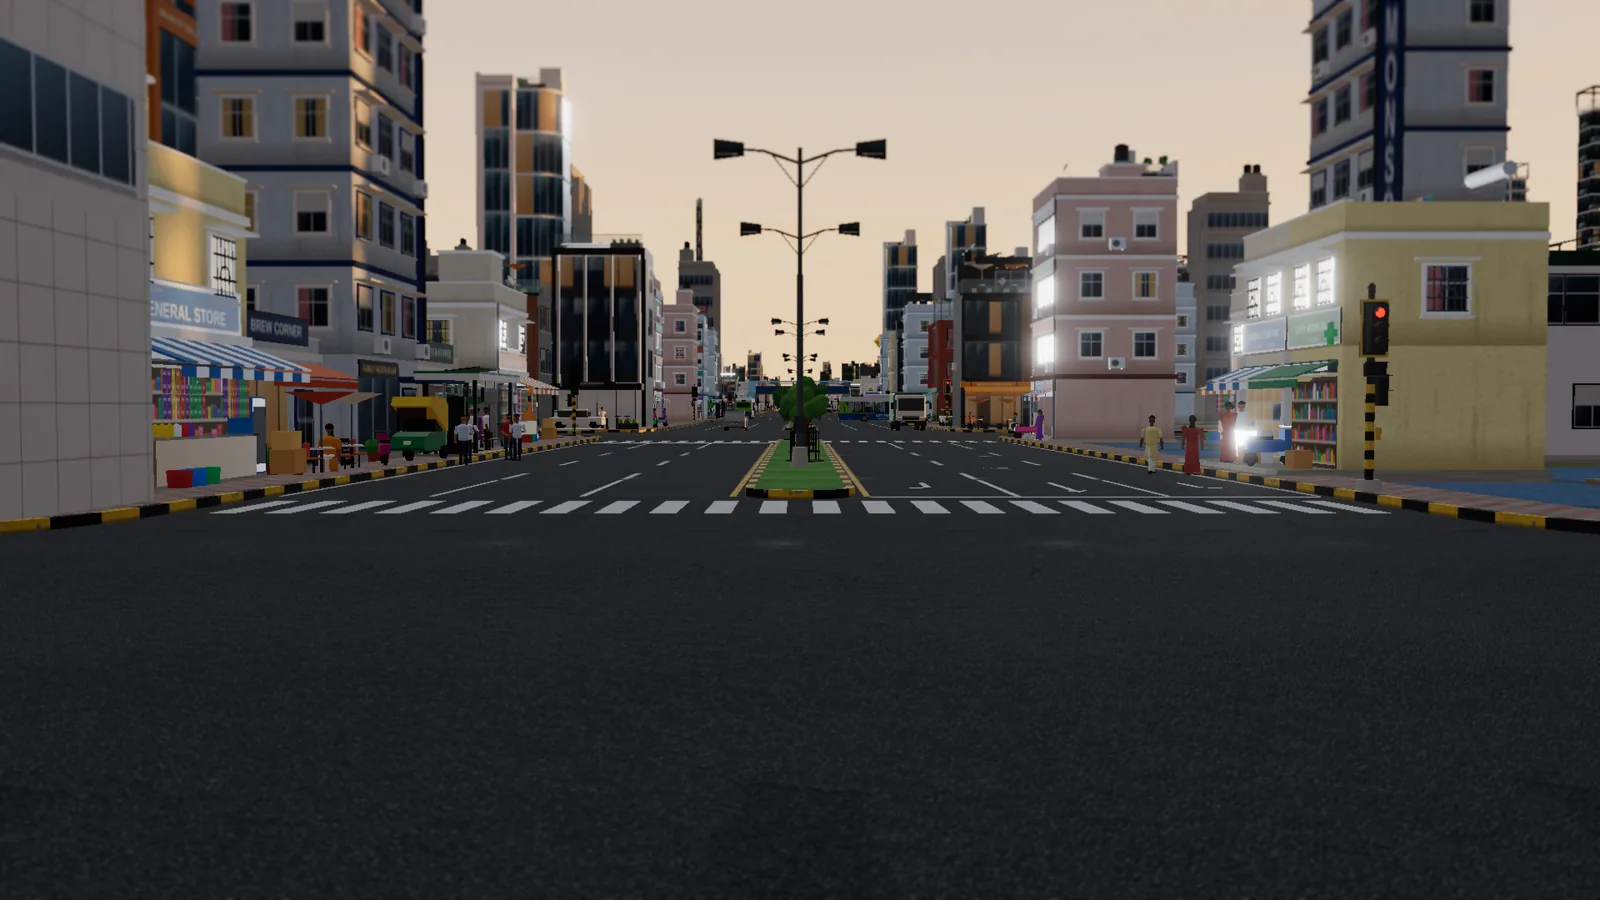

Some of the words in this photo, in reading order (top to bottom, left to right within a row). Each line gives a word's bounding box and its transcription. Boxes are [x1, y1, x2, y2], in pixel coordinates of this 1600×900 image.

[1384, 5, 1399, 201] MONS
[194, 306, 227, 327] STORE
[250, 317, 273, 334] BREW
[273, 321, 303, 338] CORNER
